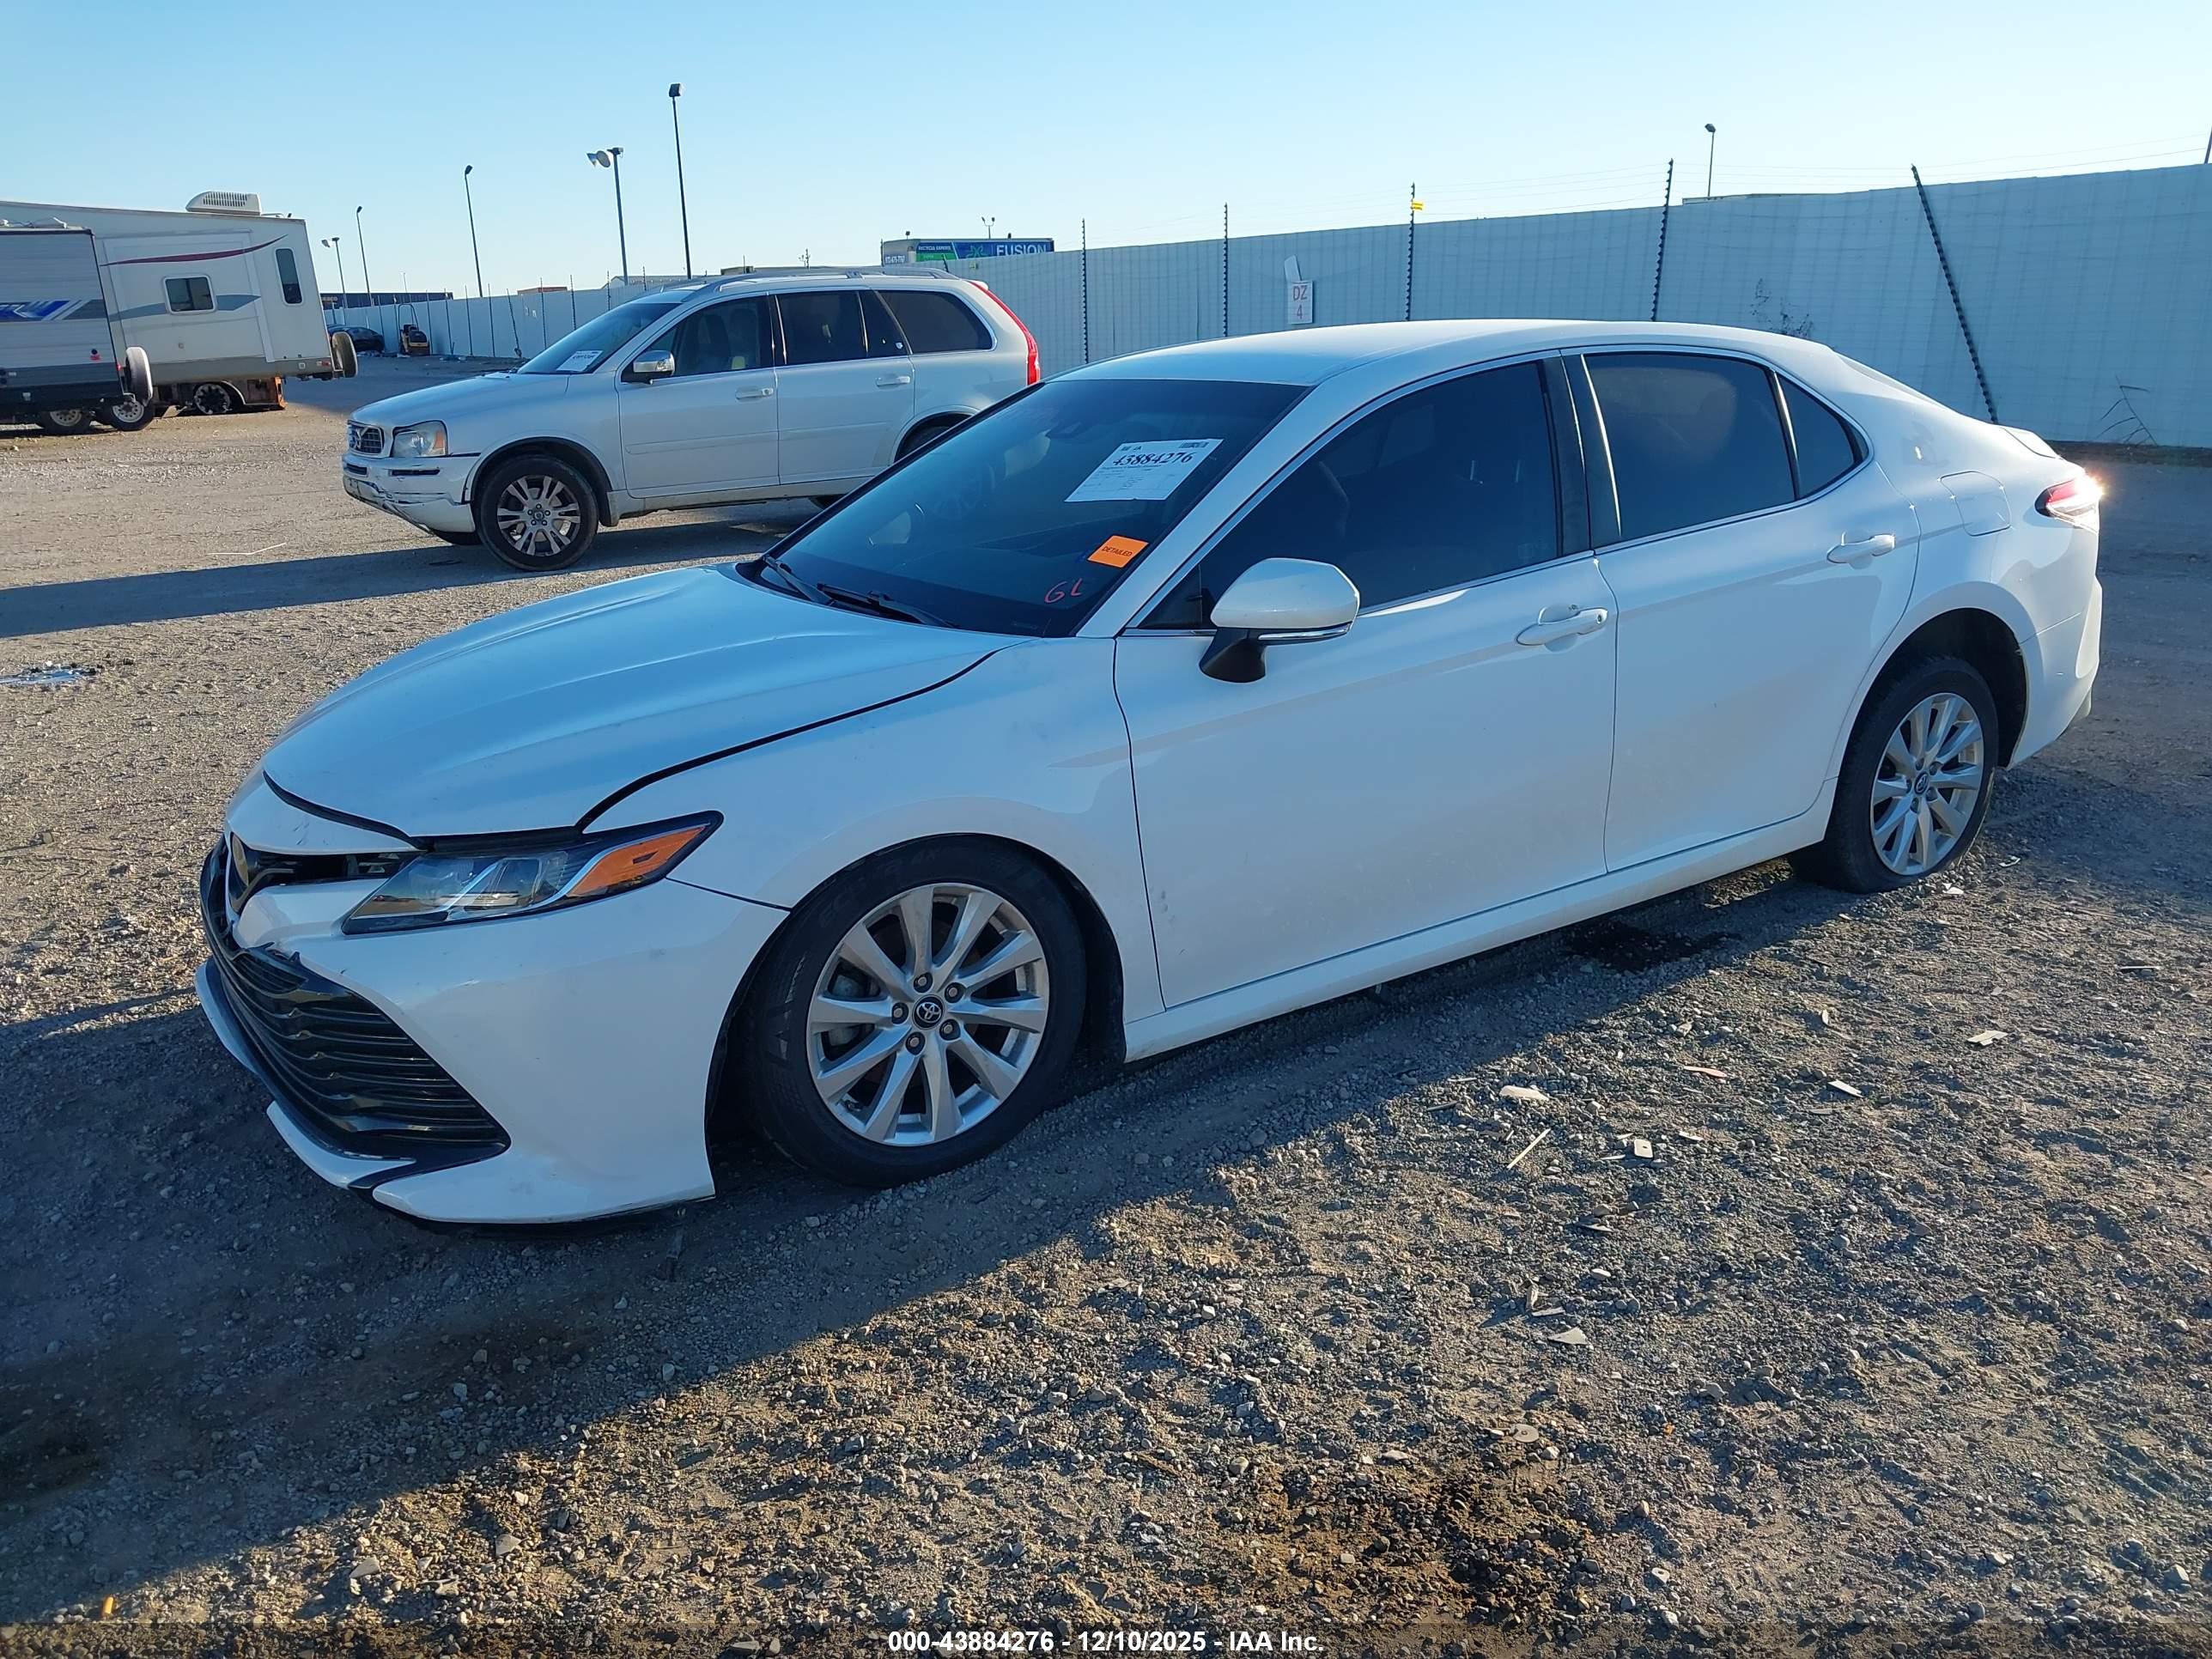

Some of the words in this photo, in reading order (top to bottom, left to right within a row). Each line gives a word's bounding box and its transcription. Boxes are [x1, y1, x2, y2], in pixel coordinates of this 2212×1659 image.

[996, 244, 1047, 257] FUSION
[1292, 284, 1308, 301] DZ
[1297, 304, 1303, 319] 4
[1113, 452, 1197, 466] 43884276
[1102, 545, 1133, 557] DETAILED
